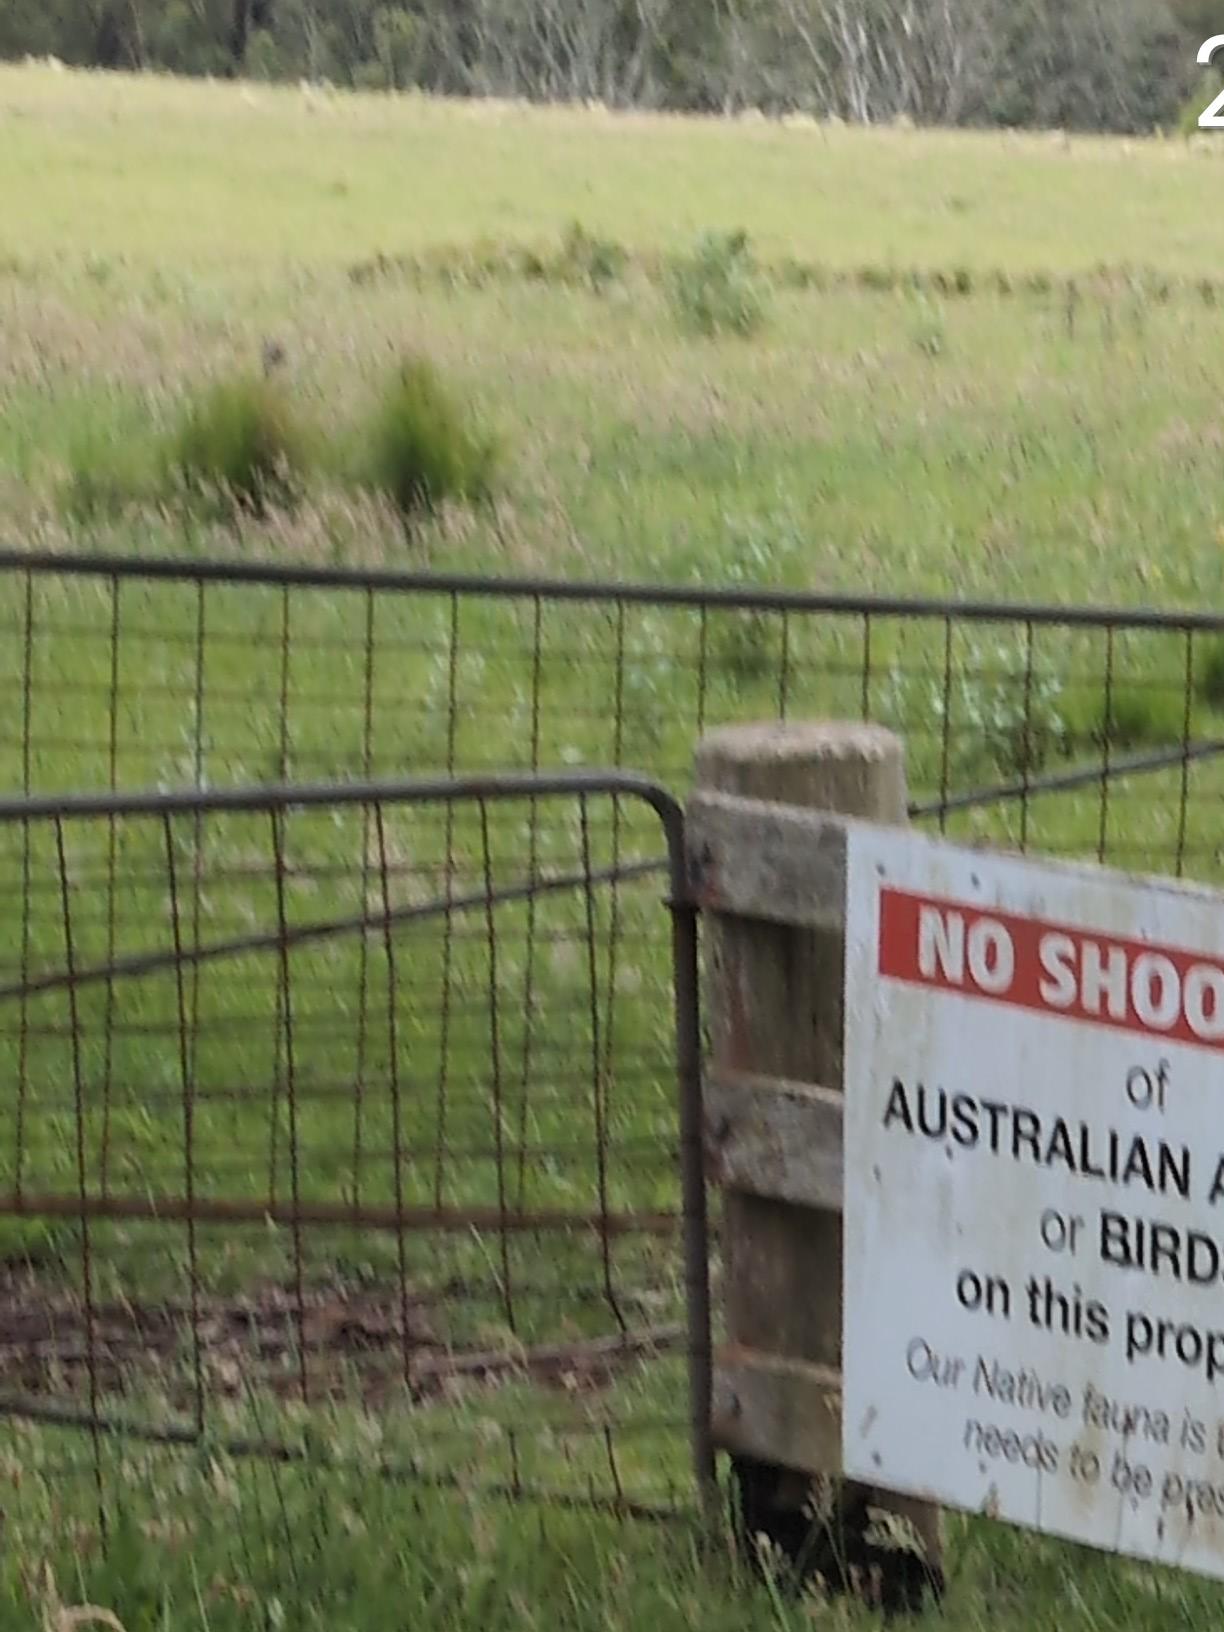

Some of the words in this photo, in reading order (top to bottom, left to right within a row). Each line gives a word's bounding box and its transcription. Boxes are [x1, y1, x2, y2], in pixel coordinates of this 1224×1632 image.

[918, 904, 1015, 994] NO
[1126, 1057, 1170, 1113] of
[883, 1076, 1190, 1198] AUSTRALIAN
[1040, 1208, 1084, 1255] or
[956, 1268, 1010, 1317] on
[1025, 1276, 1109, 1345] this
[906, 1337, 965, 1388] Our
[973, 1355, 1071, 1418] Native
[1082, 1382, 1169, 1443] fauna
[1180, 1406, 1206, 1453] is
[963, 1416, 1058, 1474] needs
[1069, 1442, 1099, 1484] to
[1111, 1453, 1152, 1498] be
